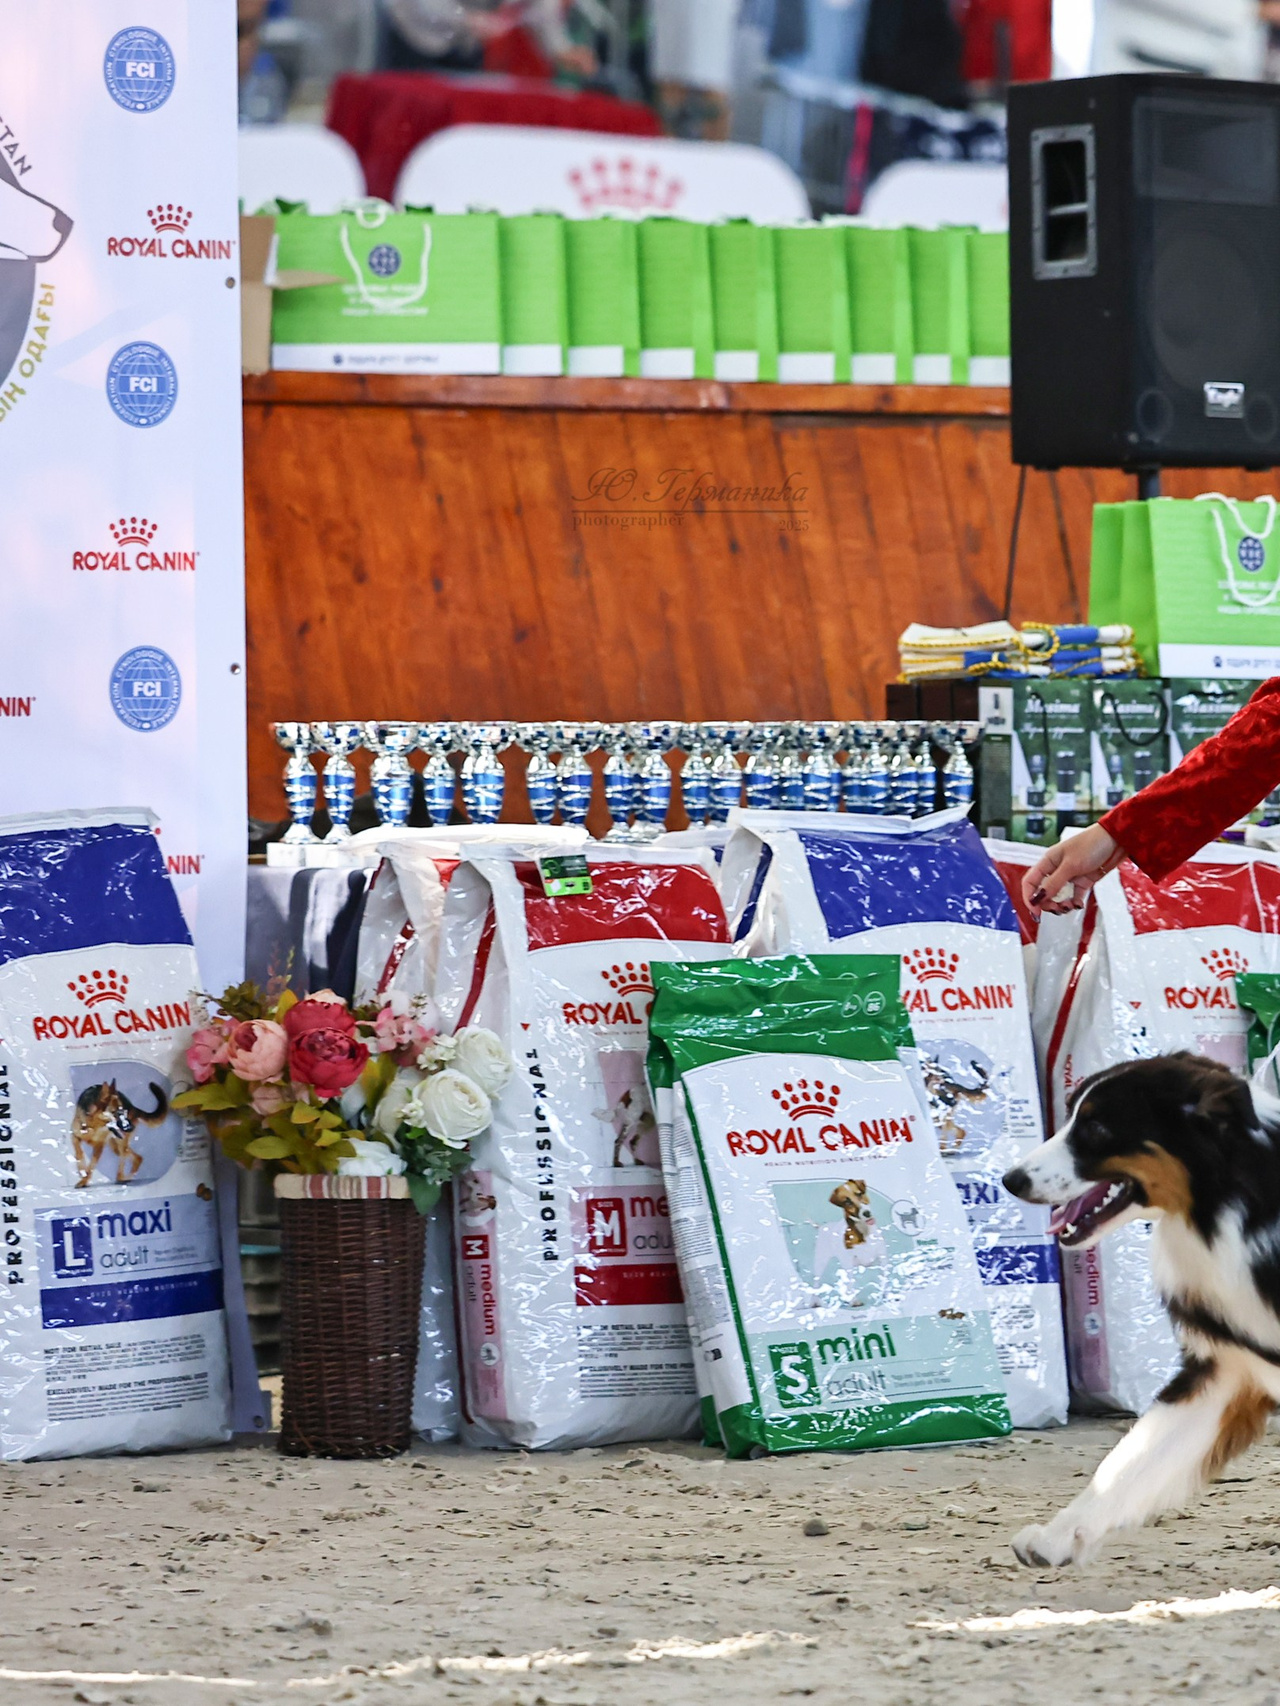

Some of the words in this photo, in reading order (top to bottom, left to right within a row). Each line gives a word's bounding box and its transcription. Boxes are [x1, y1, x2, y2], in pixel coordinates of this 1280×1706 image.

[125, 62, 156, 78] FCI
[107, 237, 167, 259] ROYAL
[171, 238, 232, 260] CANIN
[129, 377, 158, 392] FCI
[73, 551, 131, 571] ROYAL
[136, 551, 196, 571] CANIN
[132, 681, 162, 697] FCI
[0, 696, 31, 717] NIN
[168, 855, 200, 874] NIN
[901, 988, 937, 1013] YAL
[941, 984, 1013, 1011] CANIN
[1164, 986, 1236, 1009] ROYAL
[33, 1012, 113, 1041] ROYAL
[114, 1001, 191, 1034] CANIN
[562, 1001, 643, 1025] ROYAL
[726, 1126, 817, 1157] ROYAL
[819, 1116, 914, 1151] CANIN
[97, 1201, 173, 1239] maxi
[593, 1209, 622, 1246] M
[63, 1230, 87, 1267] L
[465, 1239, 484, 1256] M
[634, 1231, 673, 1250] adu
[100, 1245, 149, 1268] adult
[481, 1264, 496, 1335] medium
[816, 1324, 897, 1365] mini
[780, 1354, 809, 1396] S
